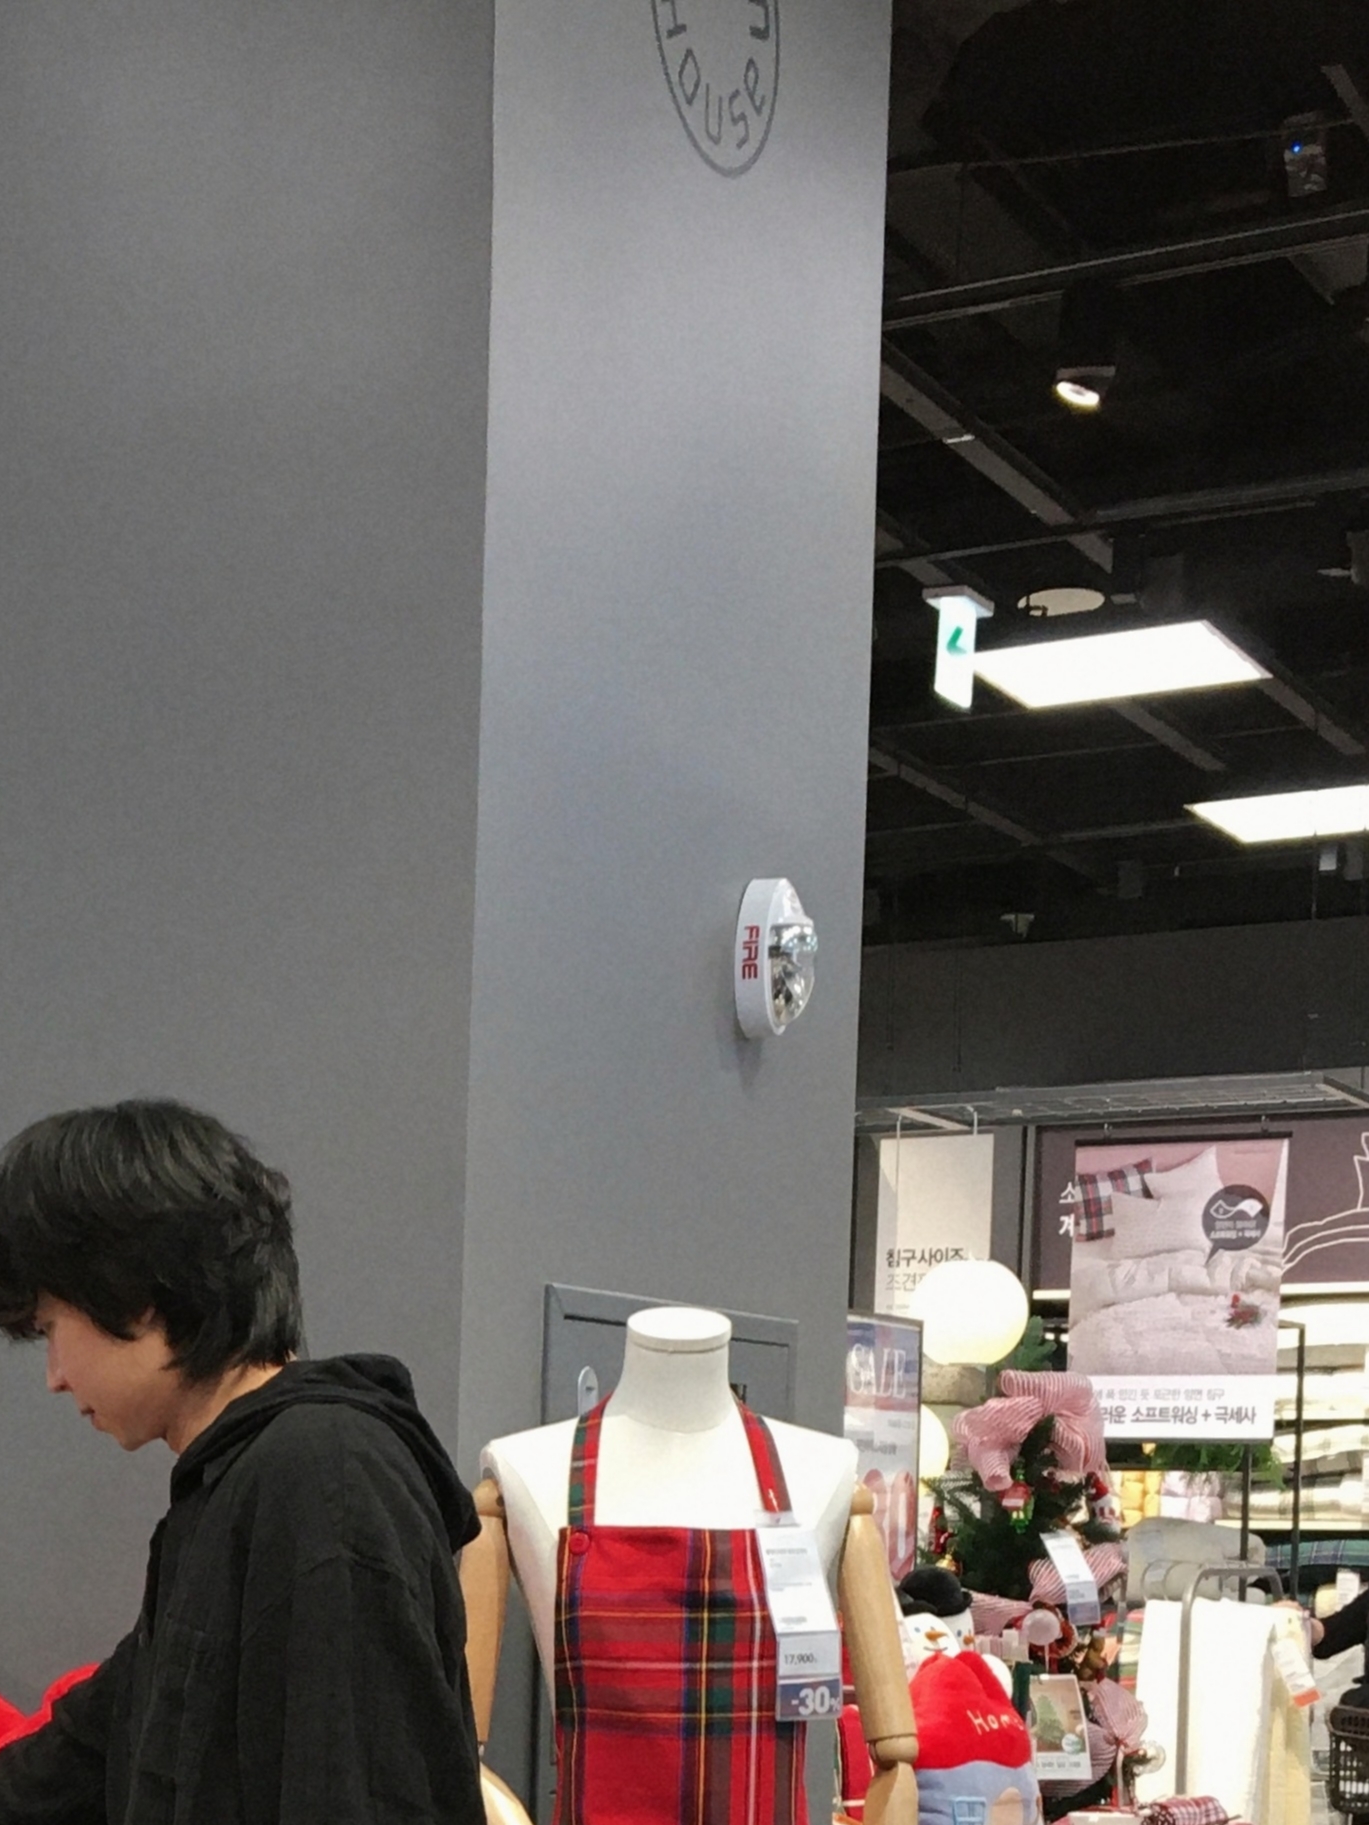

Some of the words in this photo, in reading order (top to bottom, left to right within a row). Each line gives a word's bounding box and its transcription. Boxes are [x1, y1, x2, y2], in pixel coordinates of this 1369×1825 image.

[742, 924, 760, 980] FIRE
[850, 1342, 907, 1399] SALE
[1100, 1405, 1127, 1424] 러운
[1131, 1406, 1198, 1425] 소프트워싱
[1215, 1406, 1257, 1425] 극세사
[791, 1686, 840, 1716] -30%
